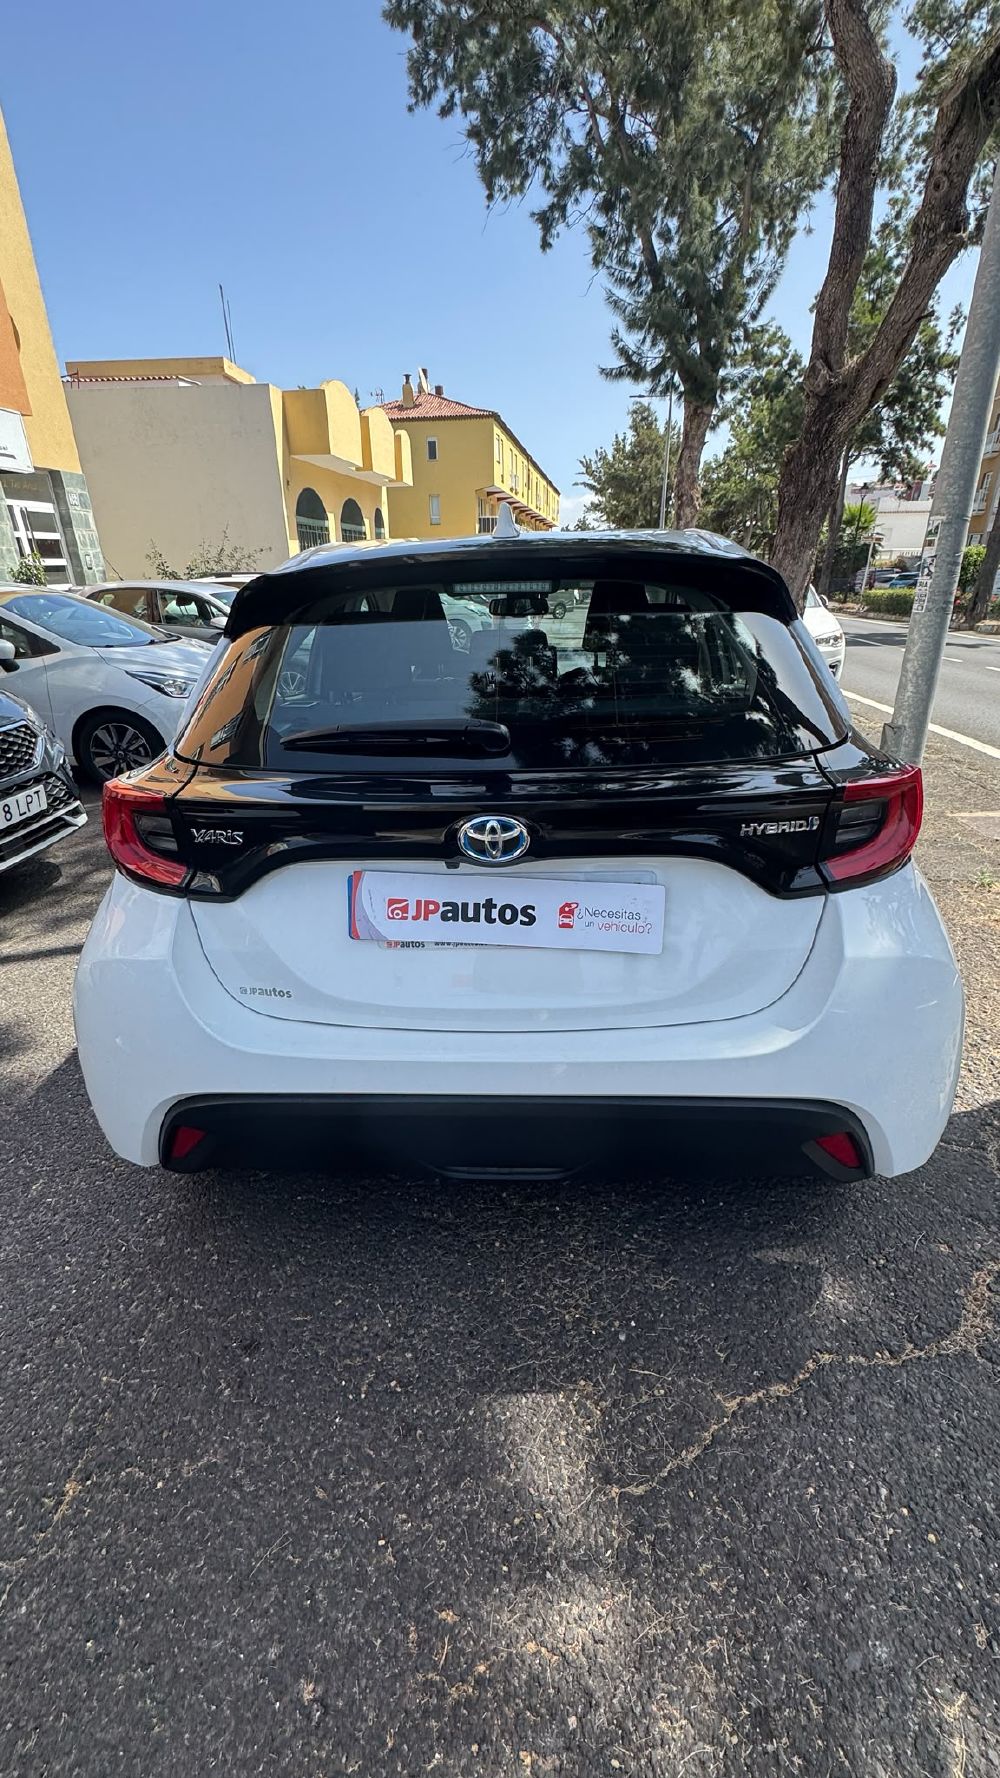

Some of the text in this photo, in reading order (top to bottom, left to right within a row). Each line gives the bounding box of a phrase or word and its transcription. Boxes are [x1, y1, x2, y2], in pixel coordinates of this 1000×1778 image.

[16, 790, 42, 817] LPT
[740, 820, 807, 837] HYBRID
[411, 897, 537, 927] JPautos
[577, 907, 641, 921] ¿Necesitas
[584, 920, 595, 928] un
